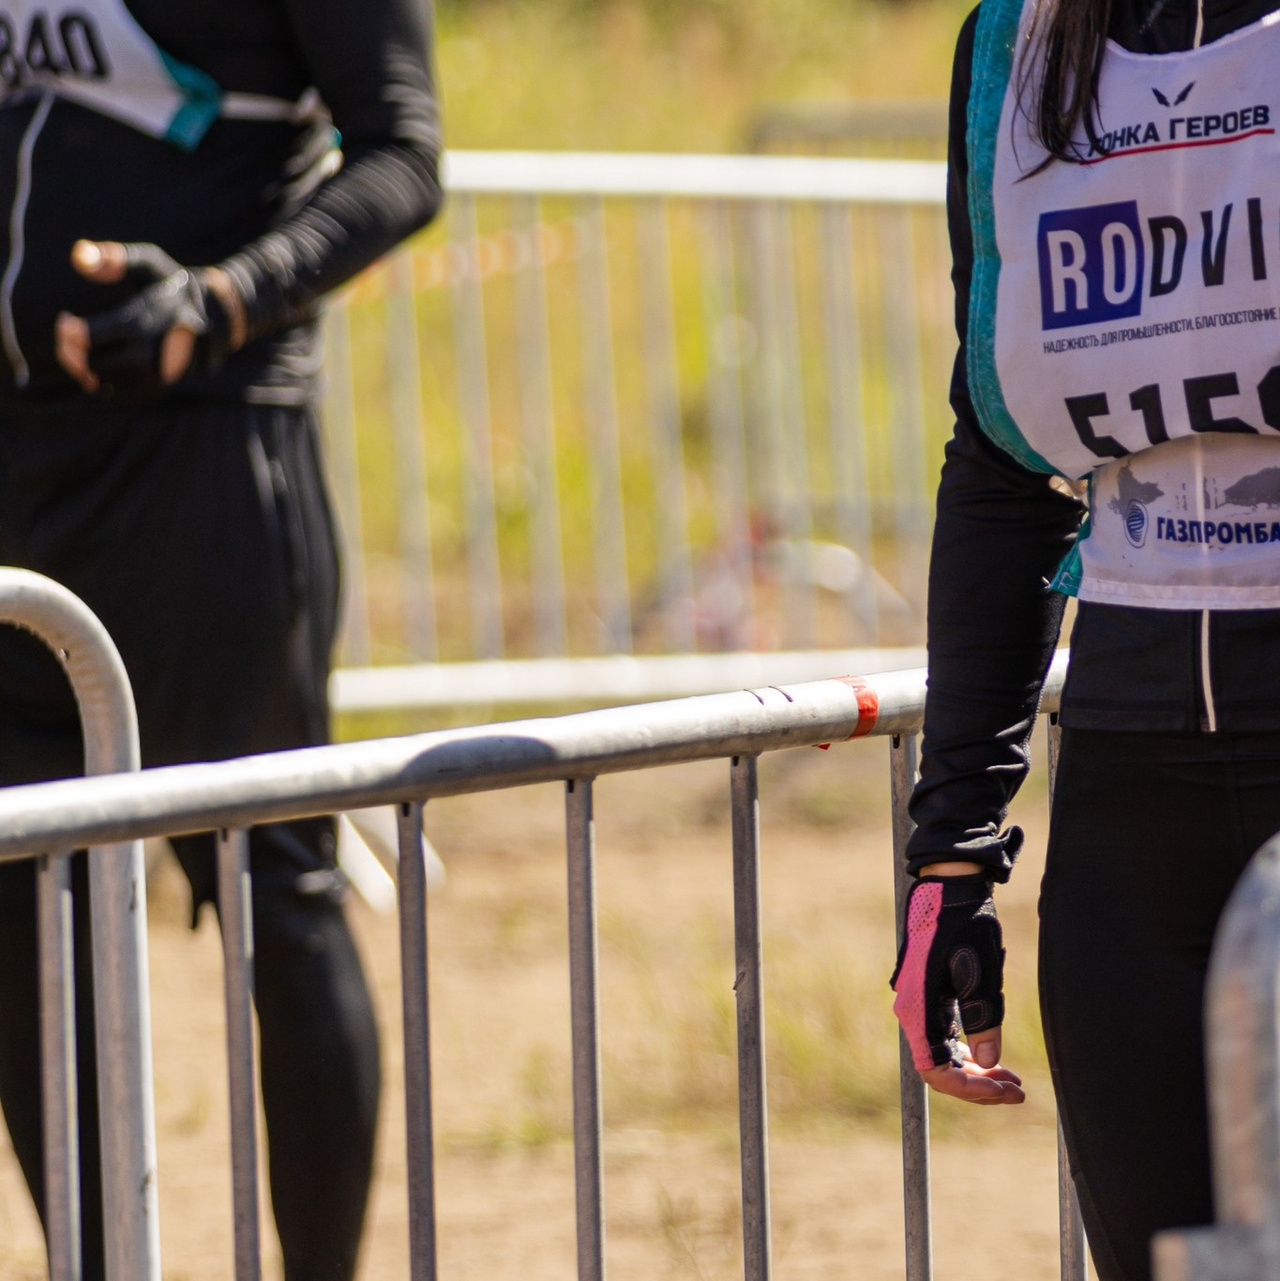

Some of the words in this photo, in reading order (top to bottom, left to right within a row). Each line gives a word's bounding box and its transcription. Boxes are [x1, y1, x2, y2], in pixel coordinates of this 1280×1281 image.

[1169, 105, 1270, 140] ГЕРОЕВ
[1043, 334, 1099, 354] НАДЕЖНОСТЬ
[1100, 331, 1118, 346] ДЛЯ
[1195, 308, 1277, 330] БЛАГОСОСТОЯНИЕ
